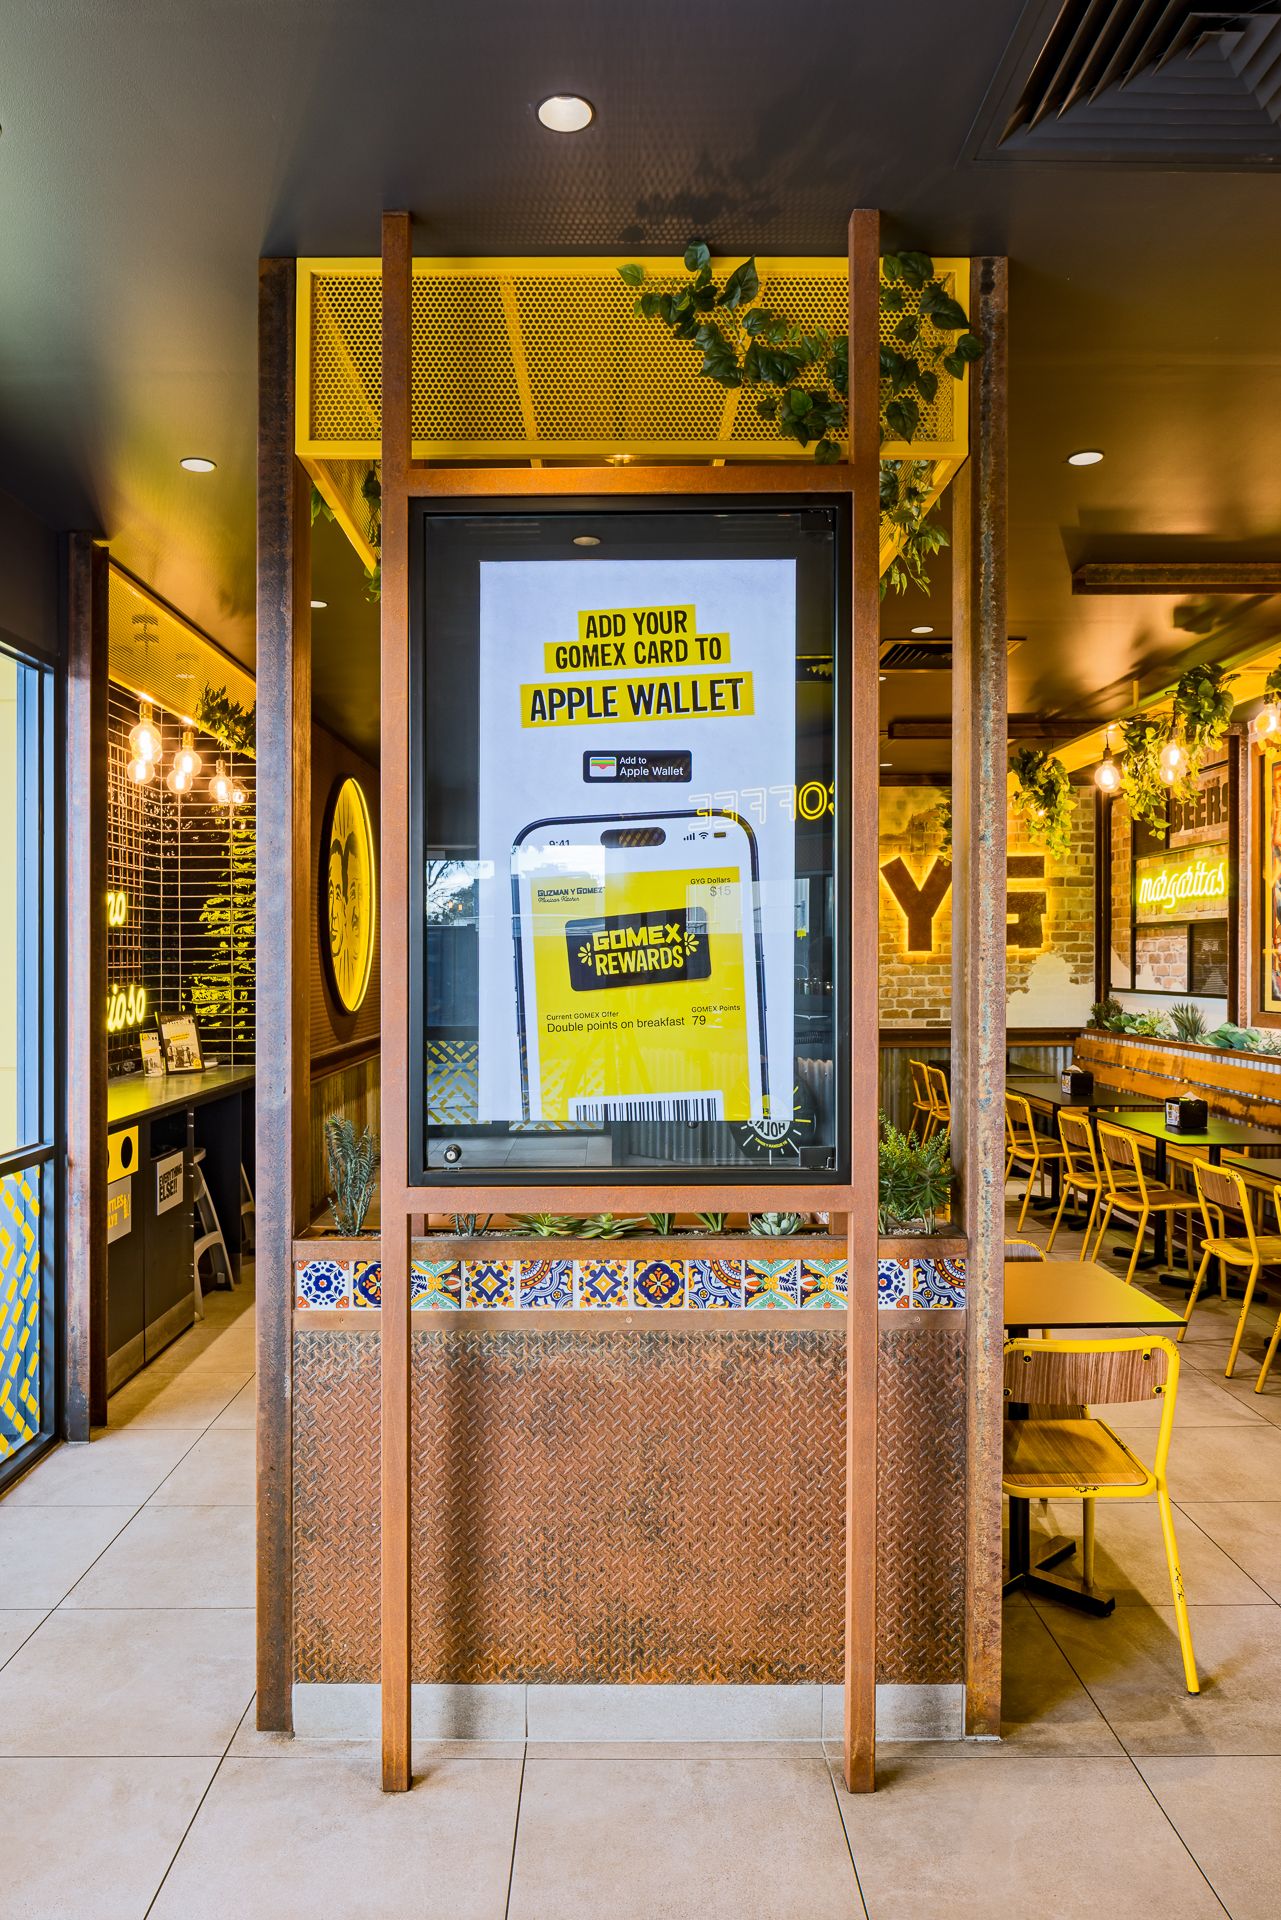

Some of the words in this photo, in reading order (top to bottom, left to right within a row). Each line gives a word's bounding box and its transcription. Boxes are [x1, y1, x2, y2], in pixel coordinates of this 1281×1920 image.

[586, 614, 626, 638] ADD
[633, 610, 688, 635] YOUR
[555, 643, 626, 669] GOMEX
[633, 639, 688, 664] CARD
[695, 637, 722, 661] TO
[530, 685, 618, 722] APPLE
[627, 677, 744, 716] WALLET
[620, 767, 649, 778] Apple
[652, 767, 684, 776] Wallet
[537, 889, 569, 897] GUZMAN
[709, 885, 731, 897] $15
[1139, 860, 1225, 909] margaritas
[592, 923, 682, 951] GOMEX
[594, 945, 684, 976] REWARDS
[546, 1013, 572, 1021] Current
[547, 1022, 583, 1033] Double
[586, 1021, 618, 1032] points
[620, 1021, 634, 1029] on
[636, 1016, 685, 1028] breakfast
[692, 1015, 706, 1026] 79
